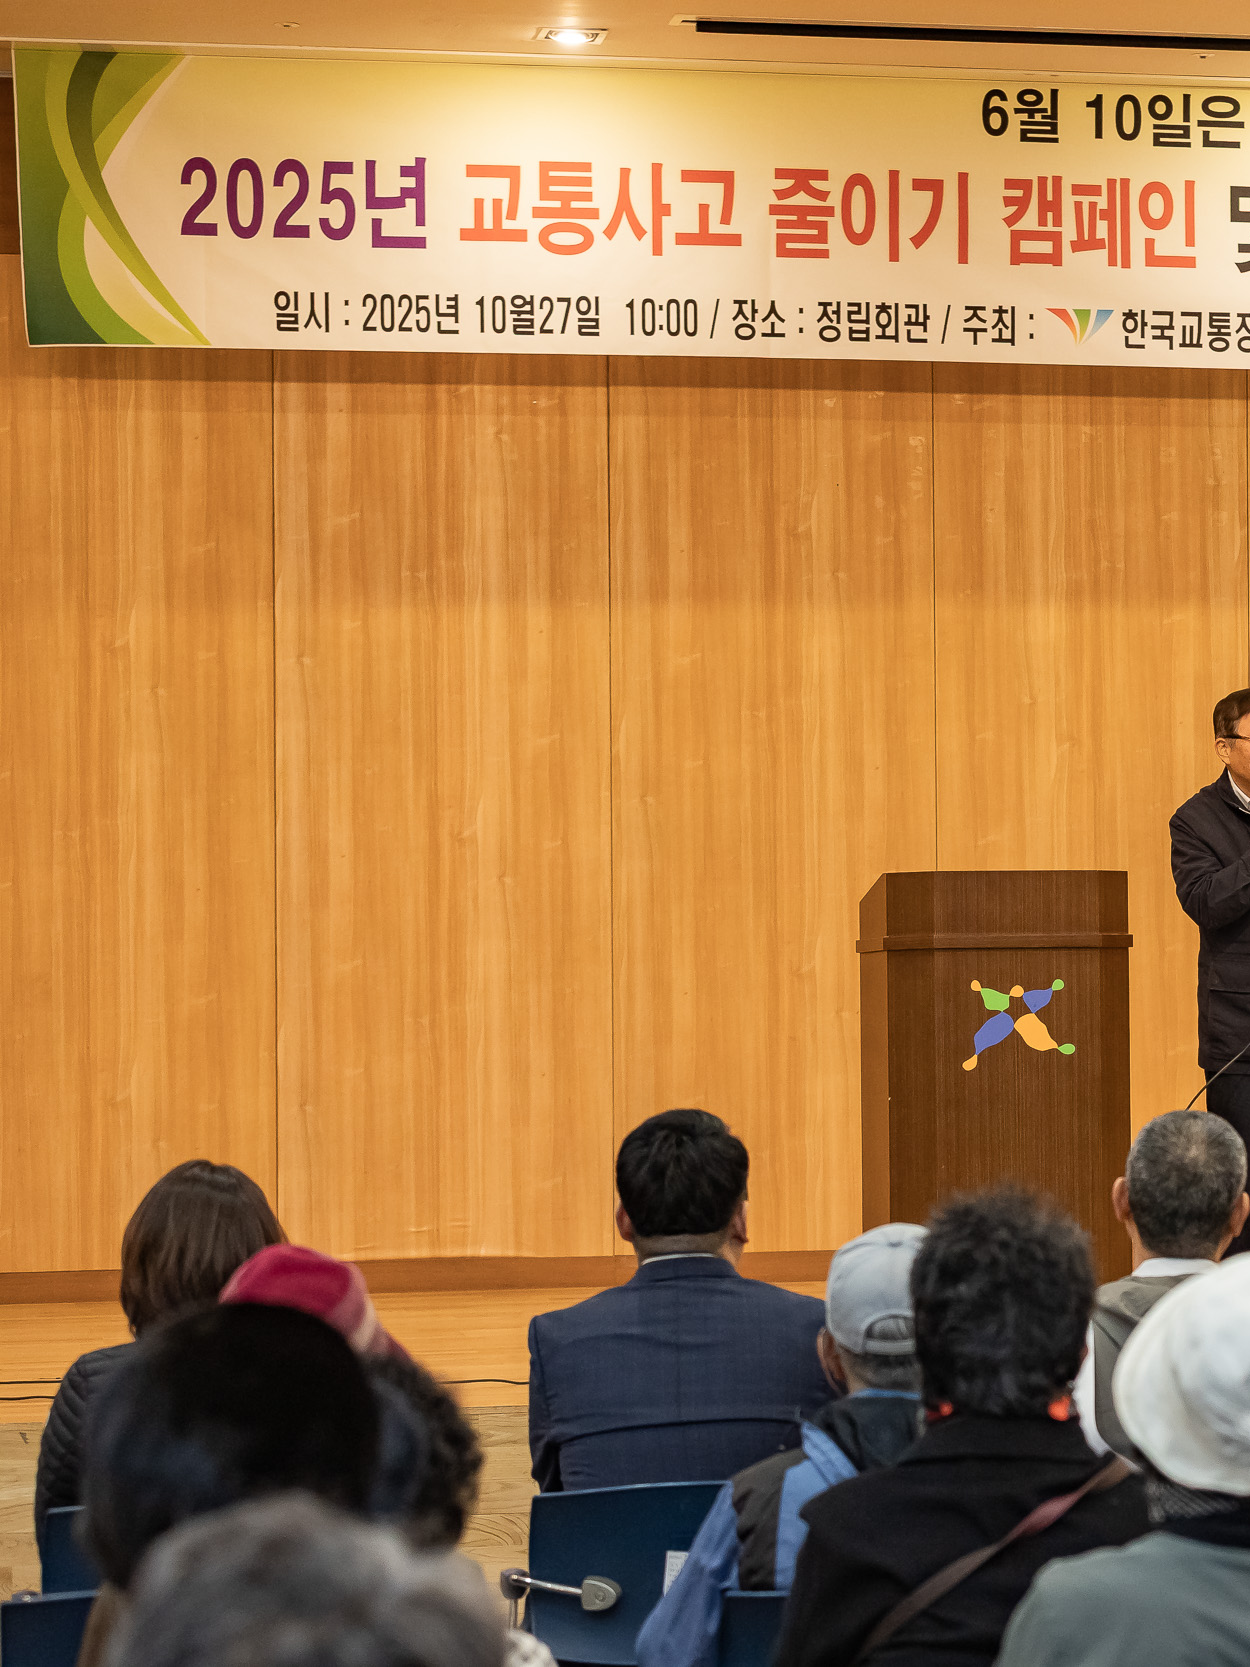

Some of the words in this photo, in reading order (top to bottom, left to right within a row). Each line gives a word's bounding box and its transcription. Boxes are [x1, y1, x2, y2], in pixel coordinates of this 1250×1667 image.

[981, 88, 1060, 144] 6월
[1084, 92, 1246, 149] 10일은
[180, 156, 427, 250] 2025년
[459, 161, 743, 257] 교통사고
[768, 167, 969, 265] 줄이기
[1001, 175, 1197, 269] 캠페인
[273, 290, 330, 333] 일시
[343, 299, 350, 326] :
[361, 293, 460, 335] 2025년
[475, 294, 600, 337] 10월27일
[625, 297, 699, 338] 10:00
[709, 298, 721, 340] /
[731, 298, 786, 341] 장소
[798, 307, 804, 334] :
[816, 300, 931, 344] 정립회관
[940, 304, 952, 345] /
[962, 305, 1016, 347] 주최
[1028, 313, 1035, 340] :
